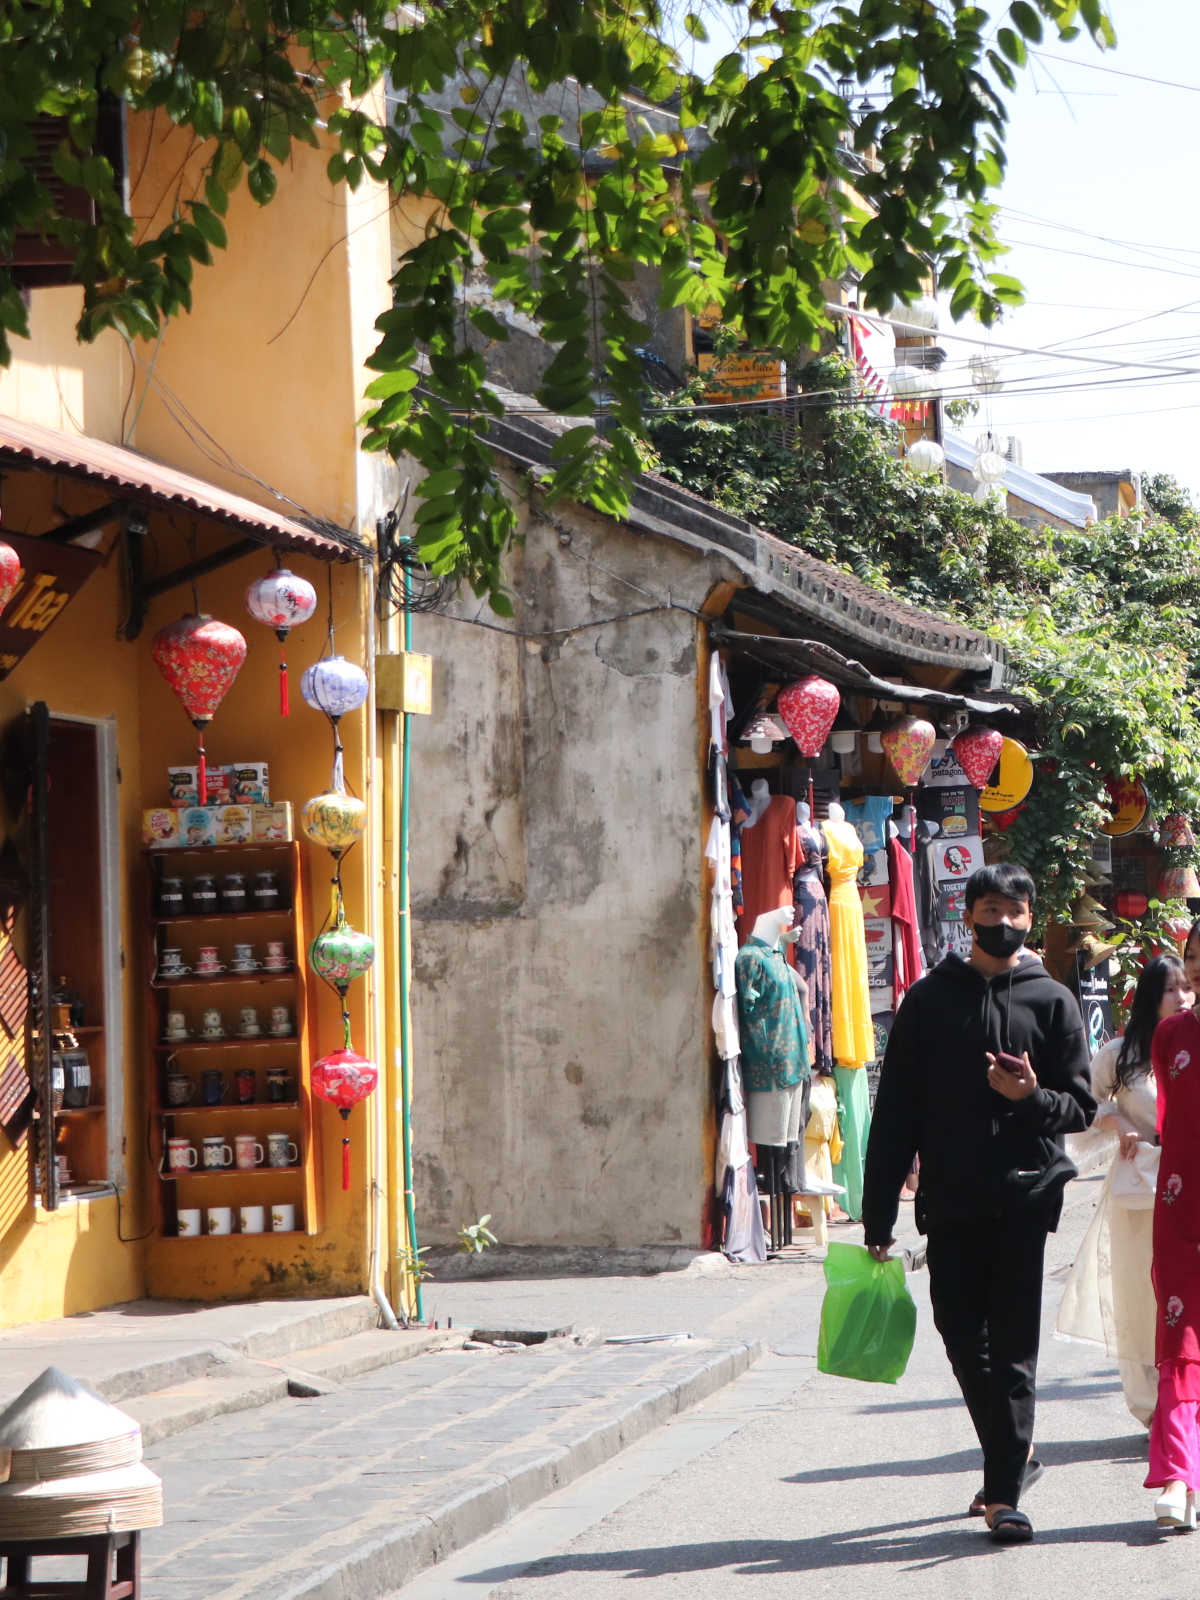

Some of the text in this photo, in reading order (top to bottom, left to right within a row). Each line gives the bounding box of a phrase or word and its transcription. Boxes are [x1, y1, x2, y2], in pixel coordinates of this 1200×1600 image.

[752, 365, 773, 373] Gifts
[7, 573, 70, 632] Tea
[932, 768, 966, 779] patagon
[985, 788, 1014, 798] Vietnam
[943, 883, 967, 892] TOGETH
[869, 977, 887, 986] das
